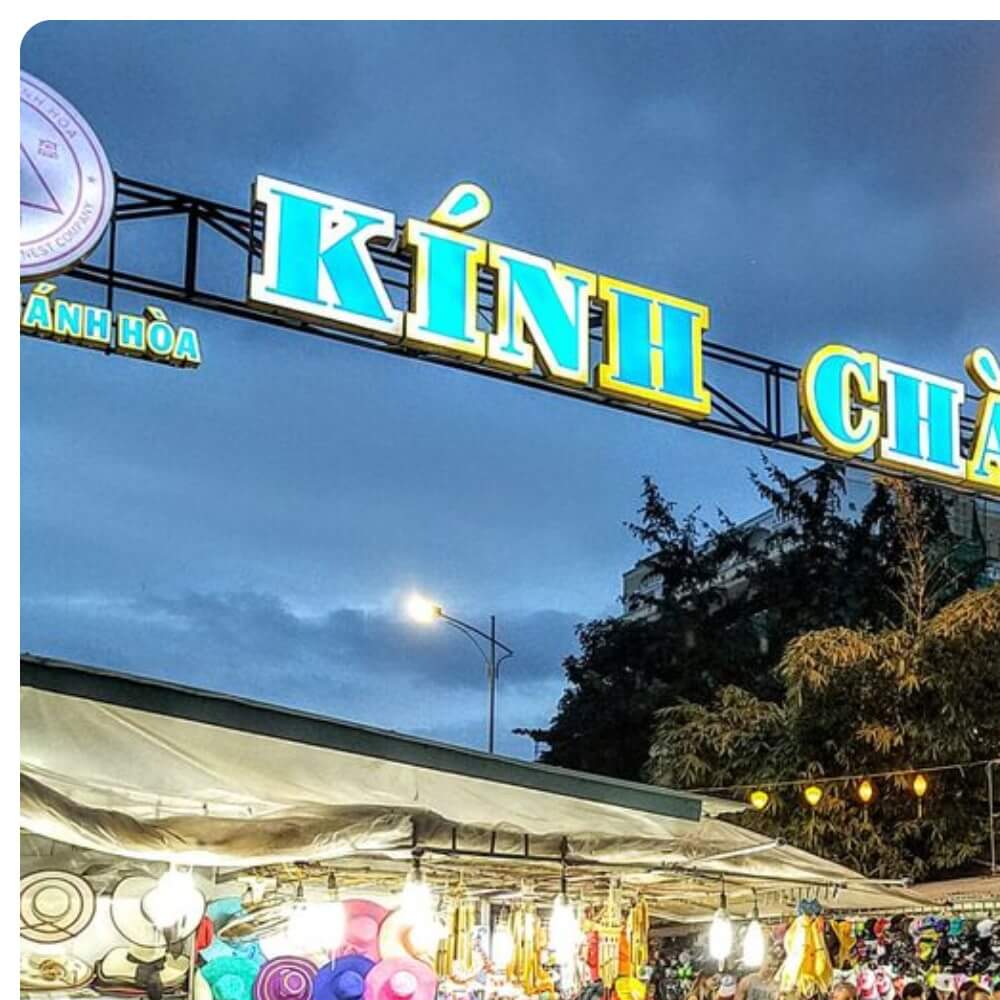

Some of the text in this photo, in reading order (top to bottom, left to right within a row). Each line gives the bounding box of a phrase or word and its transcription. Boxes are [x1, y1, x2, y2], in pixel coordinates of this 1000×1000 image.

[20, 282, 202, 364] ÁNH HÒA
[250, 174, 711, 418] KÍNH
